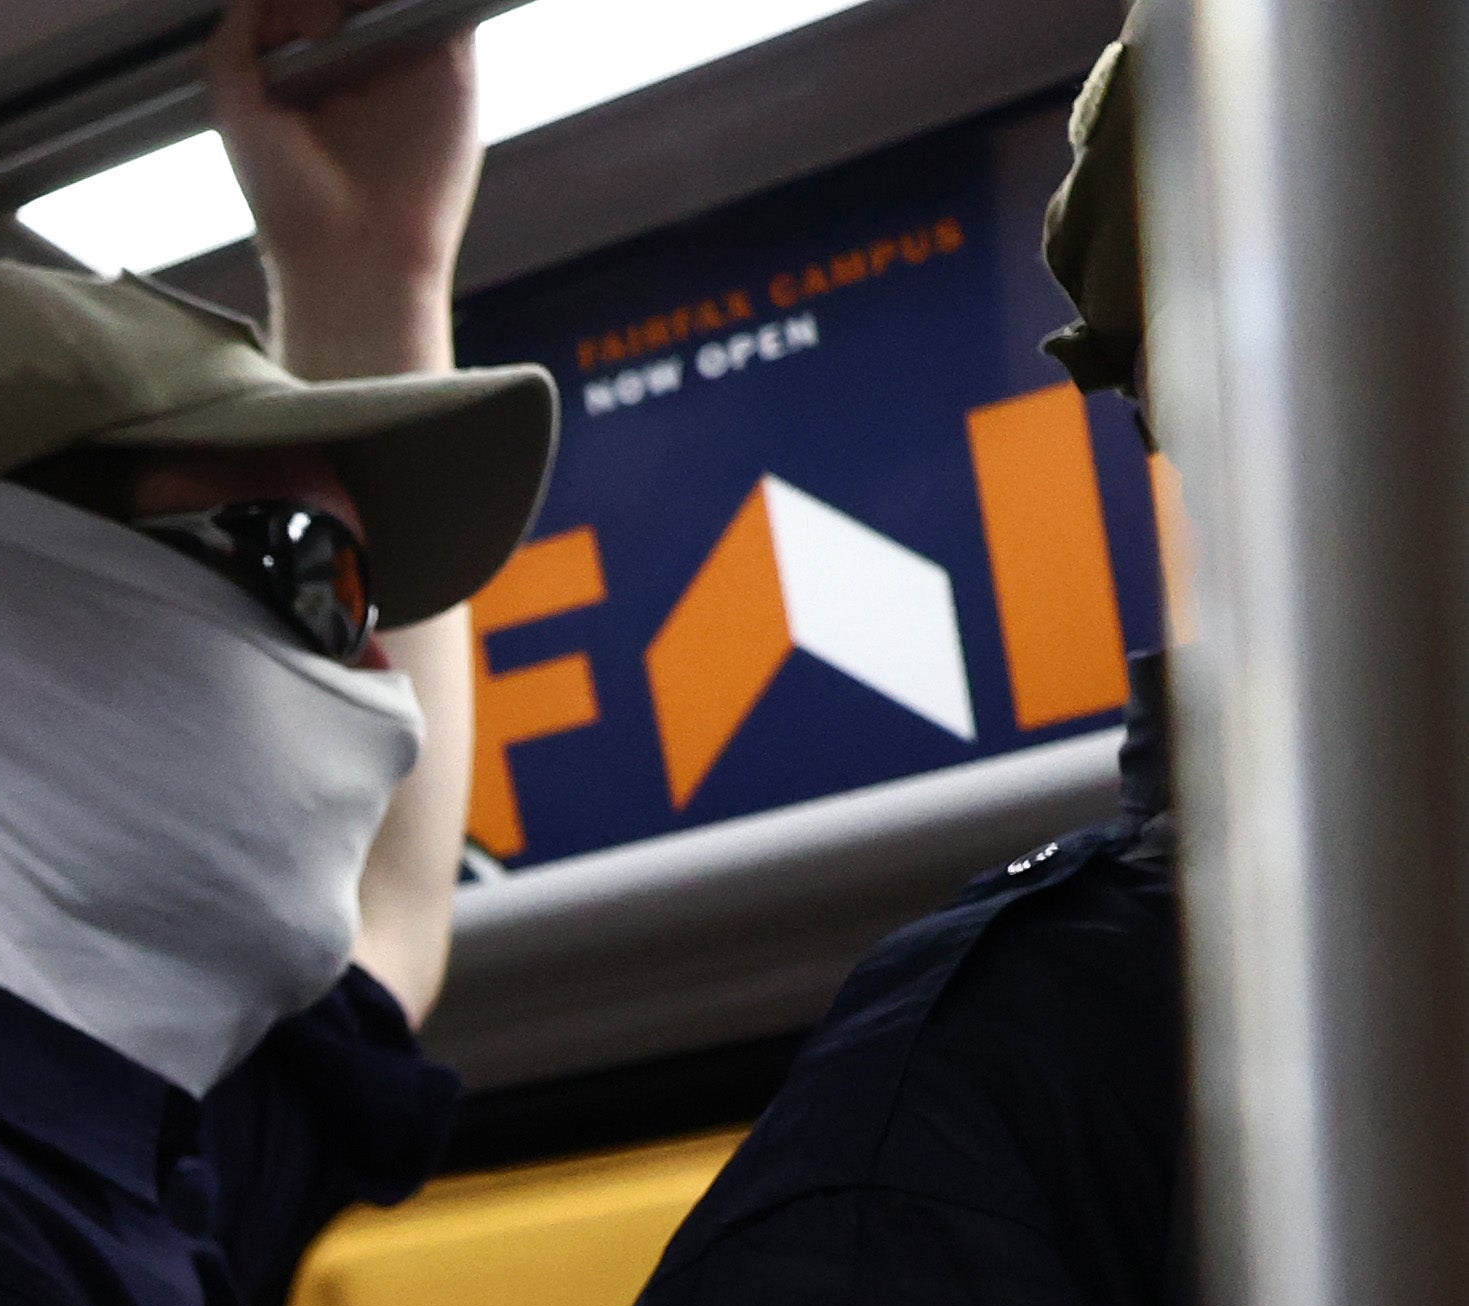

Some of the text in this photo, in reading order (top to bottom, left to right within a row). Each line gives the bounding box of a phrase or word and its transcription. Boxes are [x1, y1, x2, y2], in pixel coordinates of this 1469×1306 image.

[576, 216, 965, 370] FAIRFAX CAMPUS
[583, 311, 820, 416] NOW OPEN
